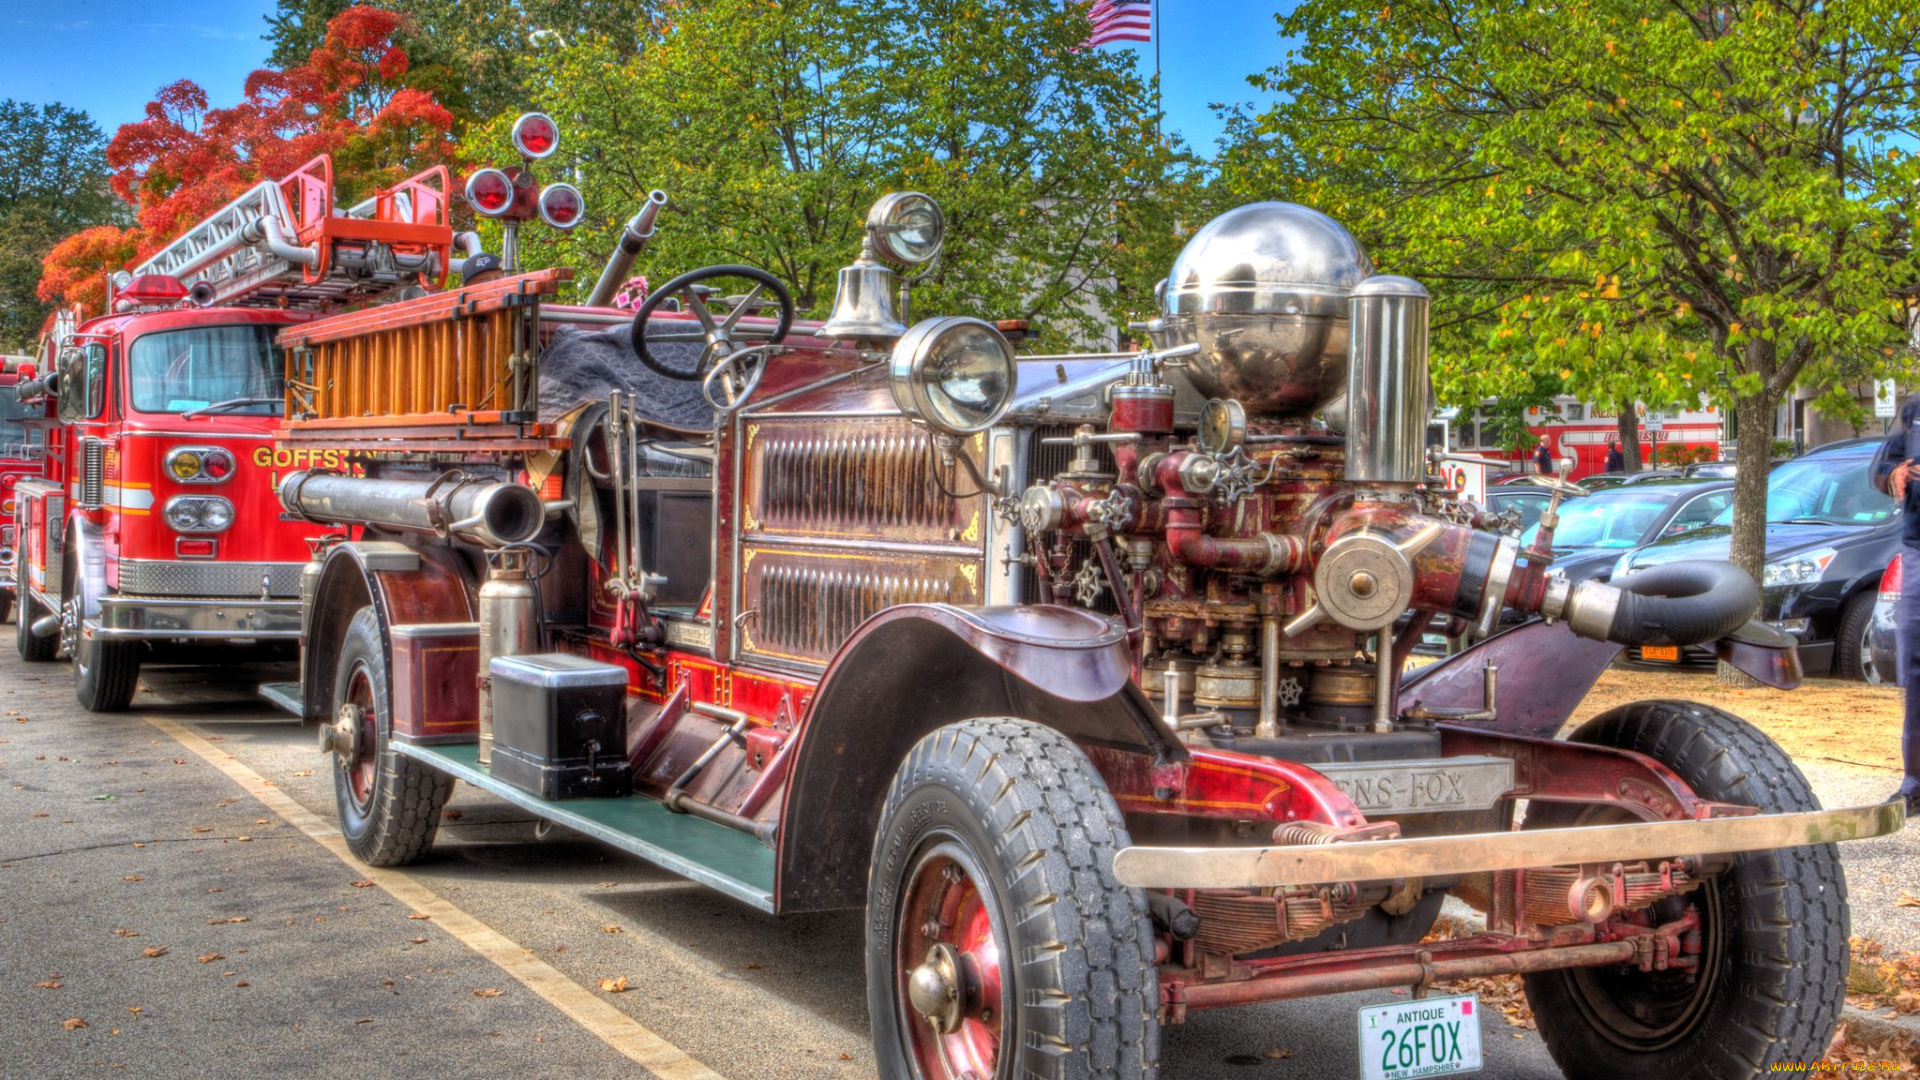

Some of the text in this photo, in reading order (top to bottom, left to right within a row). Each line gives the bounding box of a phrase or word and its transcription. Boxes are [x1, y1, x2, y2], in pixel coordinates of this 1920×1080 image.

[1604, 431, 1620, 442] FIR
[1397, 1008, 1444, 1024] ANTIQUE
[1381, 1021, 1462, 1070] 26FOX
[1391, 1062, 1456, 1079] NEW HAMPSHIRE
